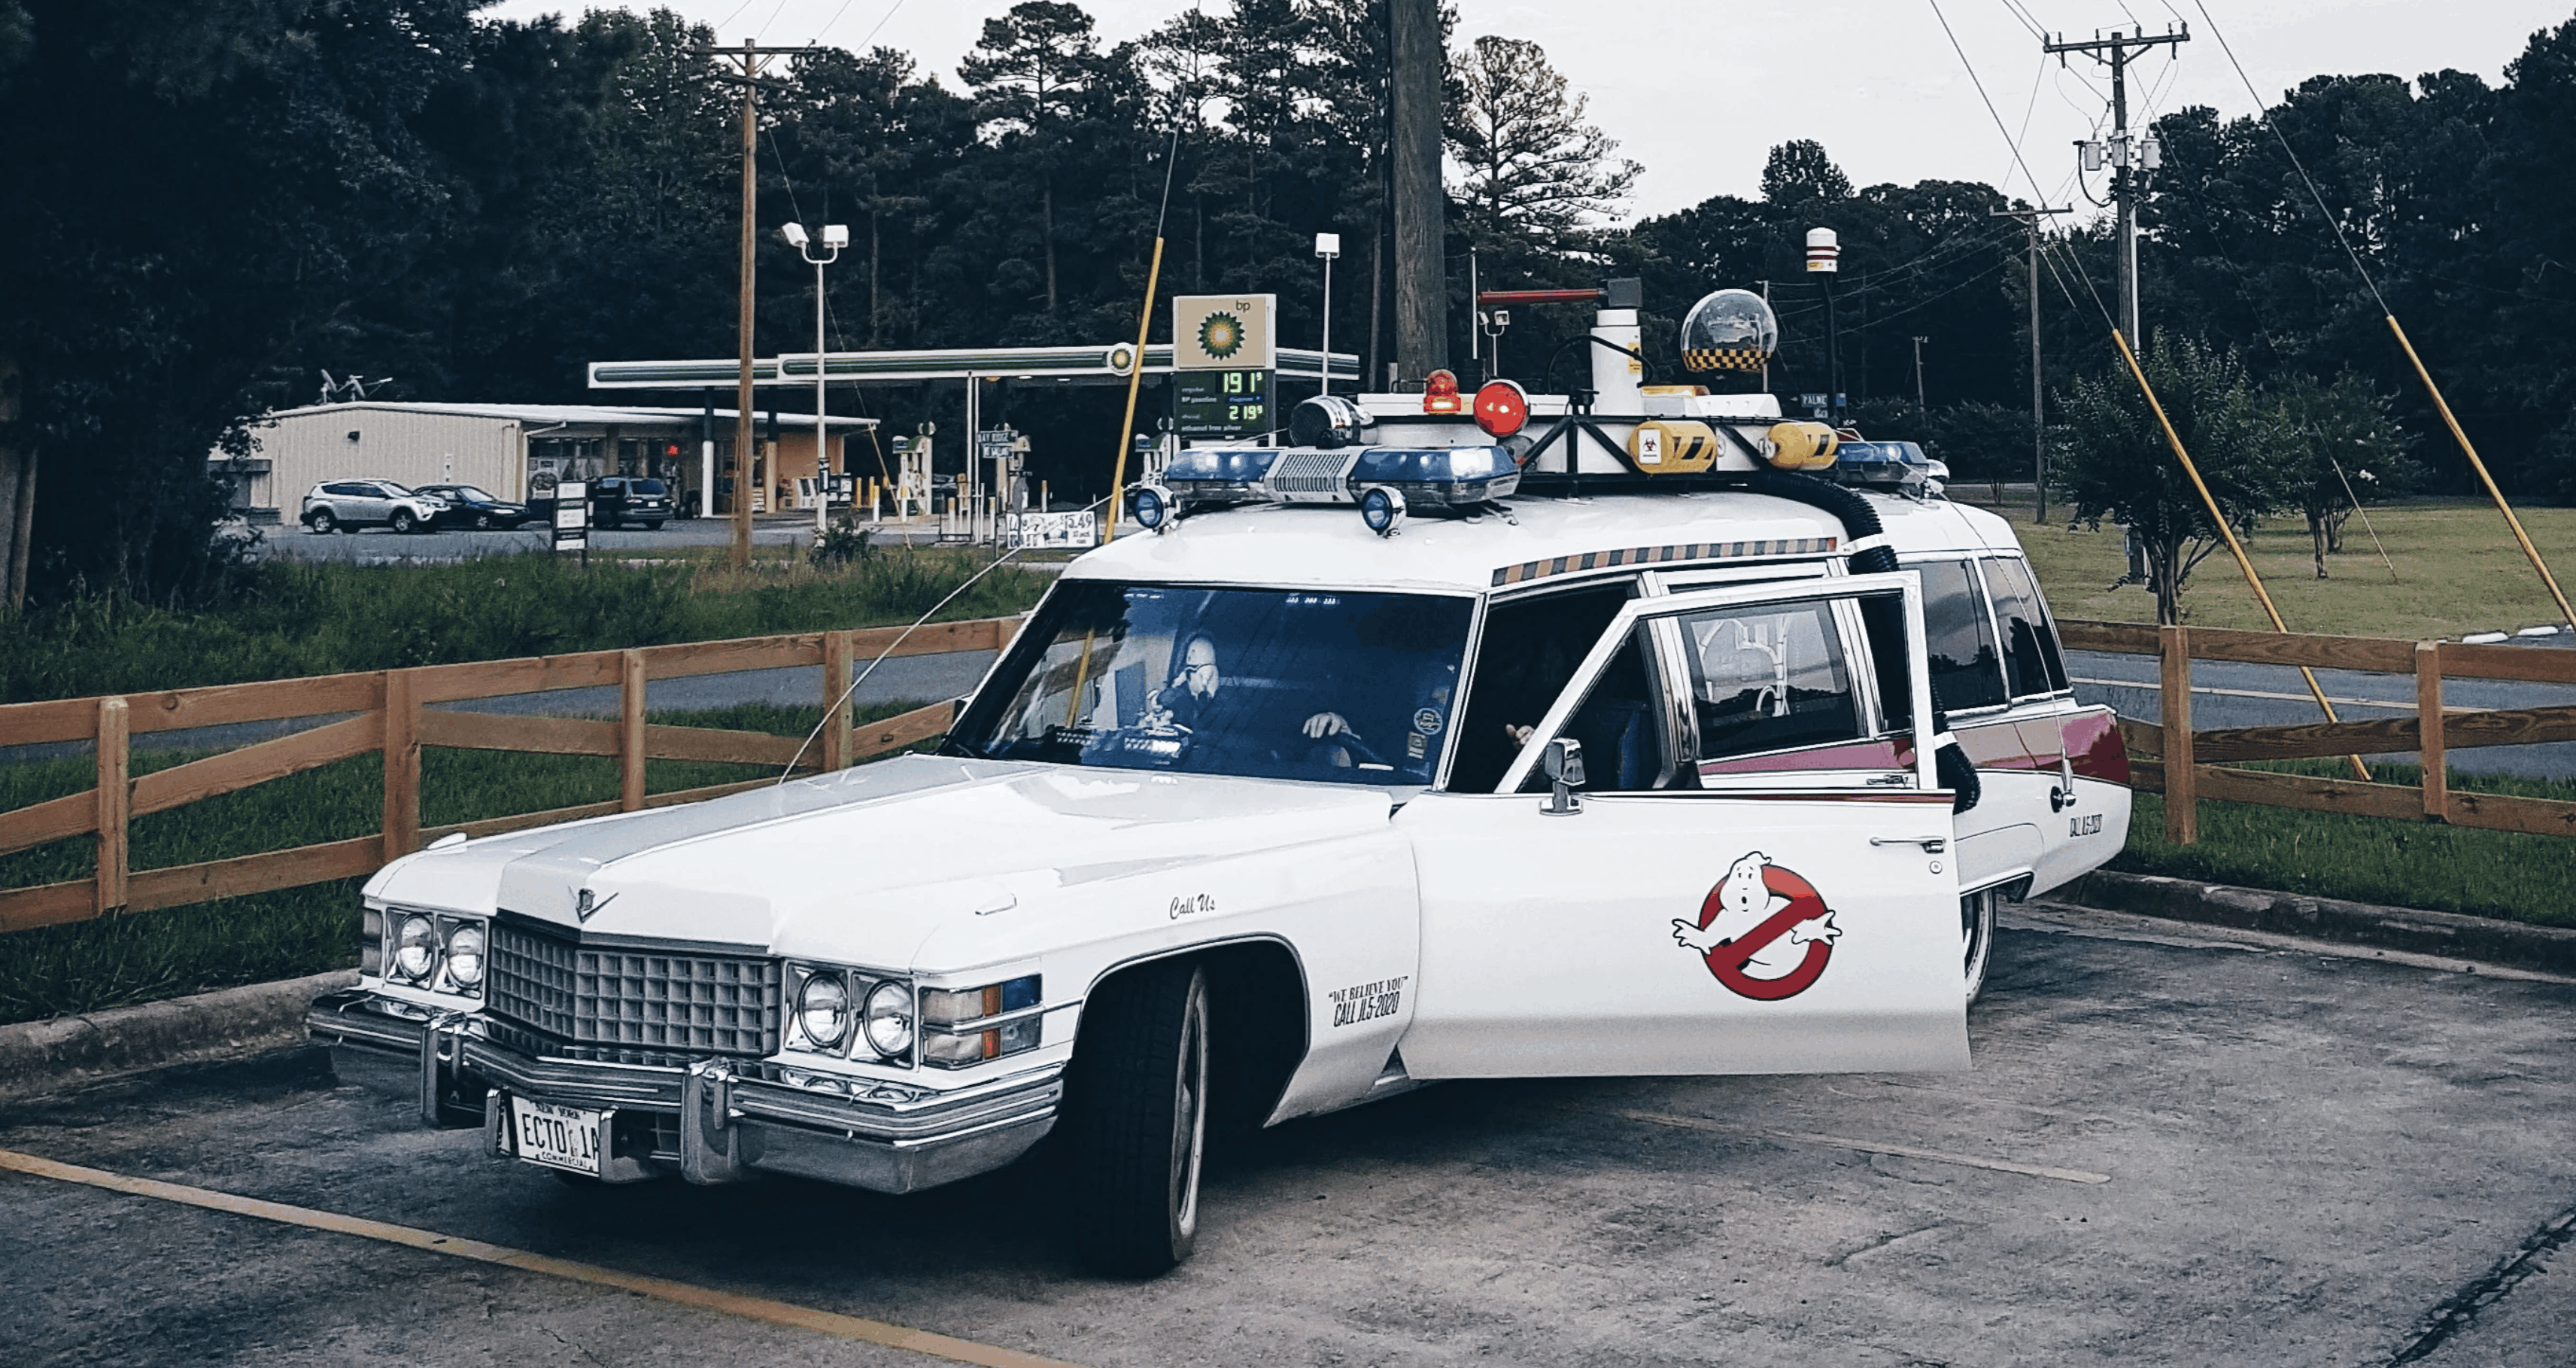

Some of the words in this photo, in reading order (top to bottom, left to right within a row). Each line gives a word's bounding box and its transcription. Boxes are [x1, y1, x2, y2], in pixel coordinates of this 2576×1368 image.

[1236, 300, 1250, 312] bp
[1169, 896, 1195, 920] Call
[1197, 893, 1216, 912] Us
[1349, 980, 1385, 1001] BELIEVE
[1333, 1000, 1356, 1028] CALL
[1356, 990, 1400, 1023] JL5-2020
[522, 1112, 567, 1154] ECTO
[541, 1151, 588, 1169] COMMERCIAL
